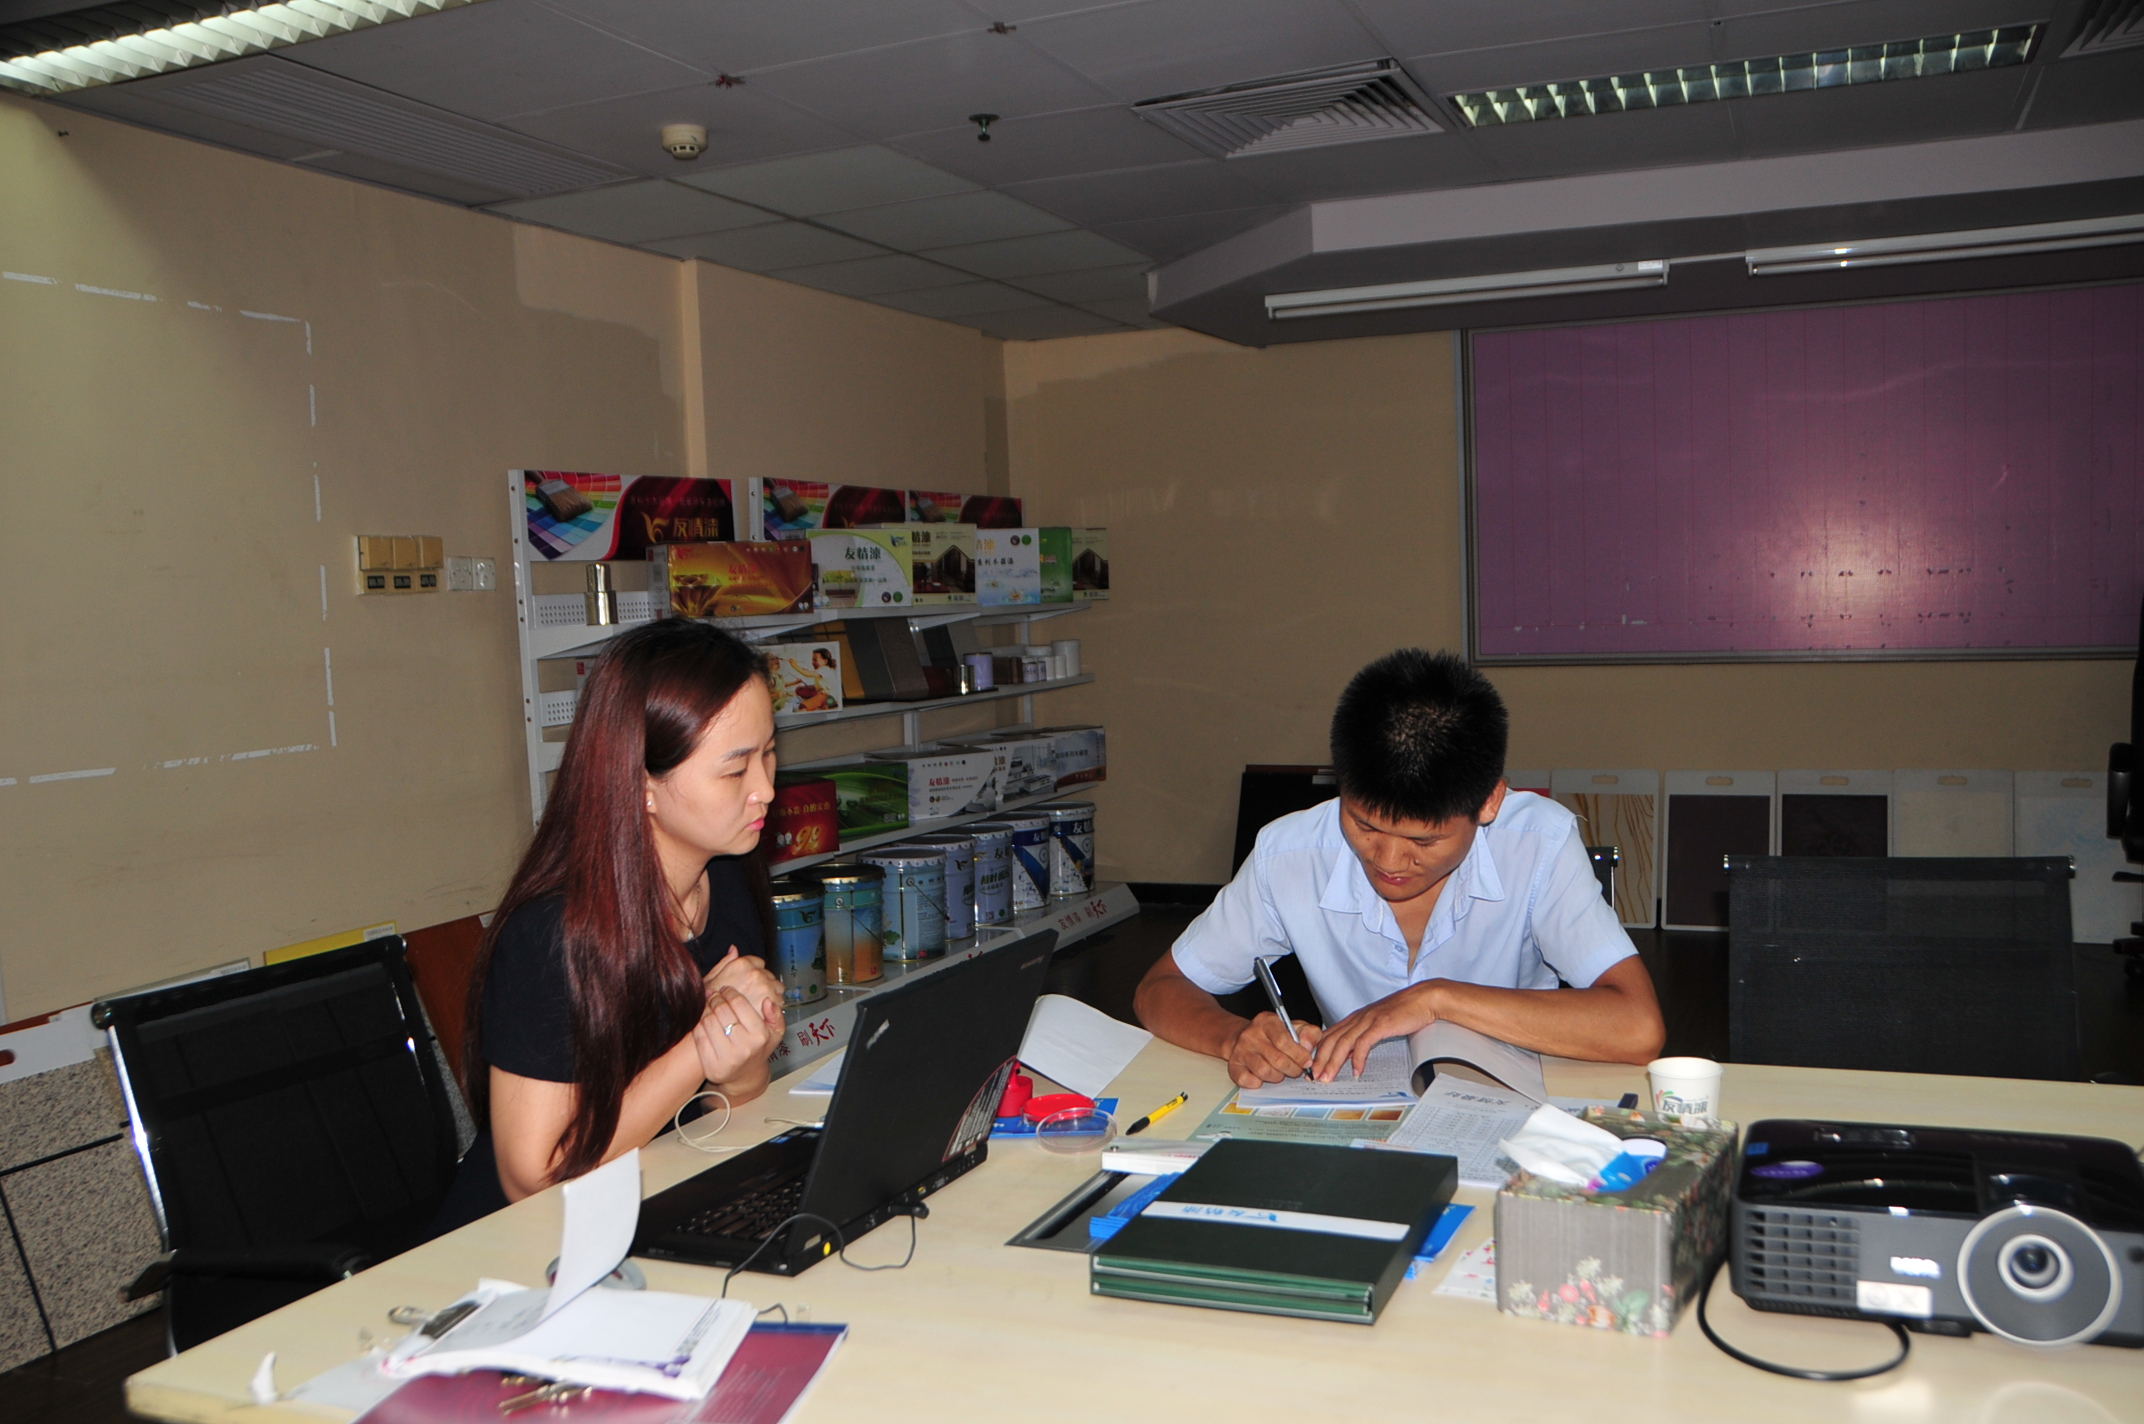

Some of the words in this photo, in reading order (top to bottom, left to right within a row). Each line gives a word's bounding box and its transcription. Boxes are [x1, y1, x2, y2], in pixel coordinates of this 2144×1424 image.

[845, 546, 881, 560] 友情漆
[929, 776, 951, 787] 友情漆
[1058, 911, 1083, 930] 友情漆
[796, 1018, 836, 1046] 刷天下
